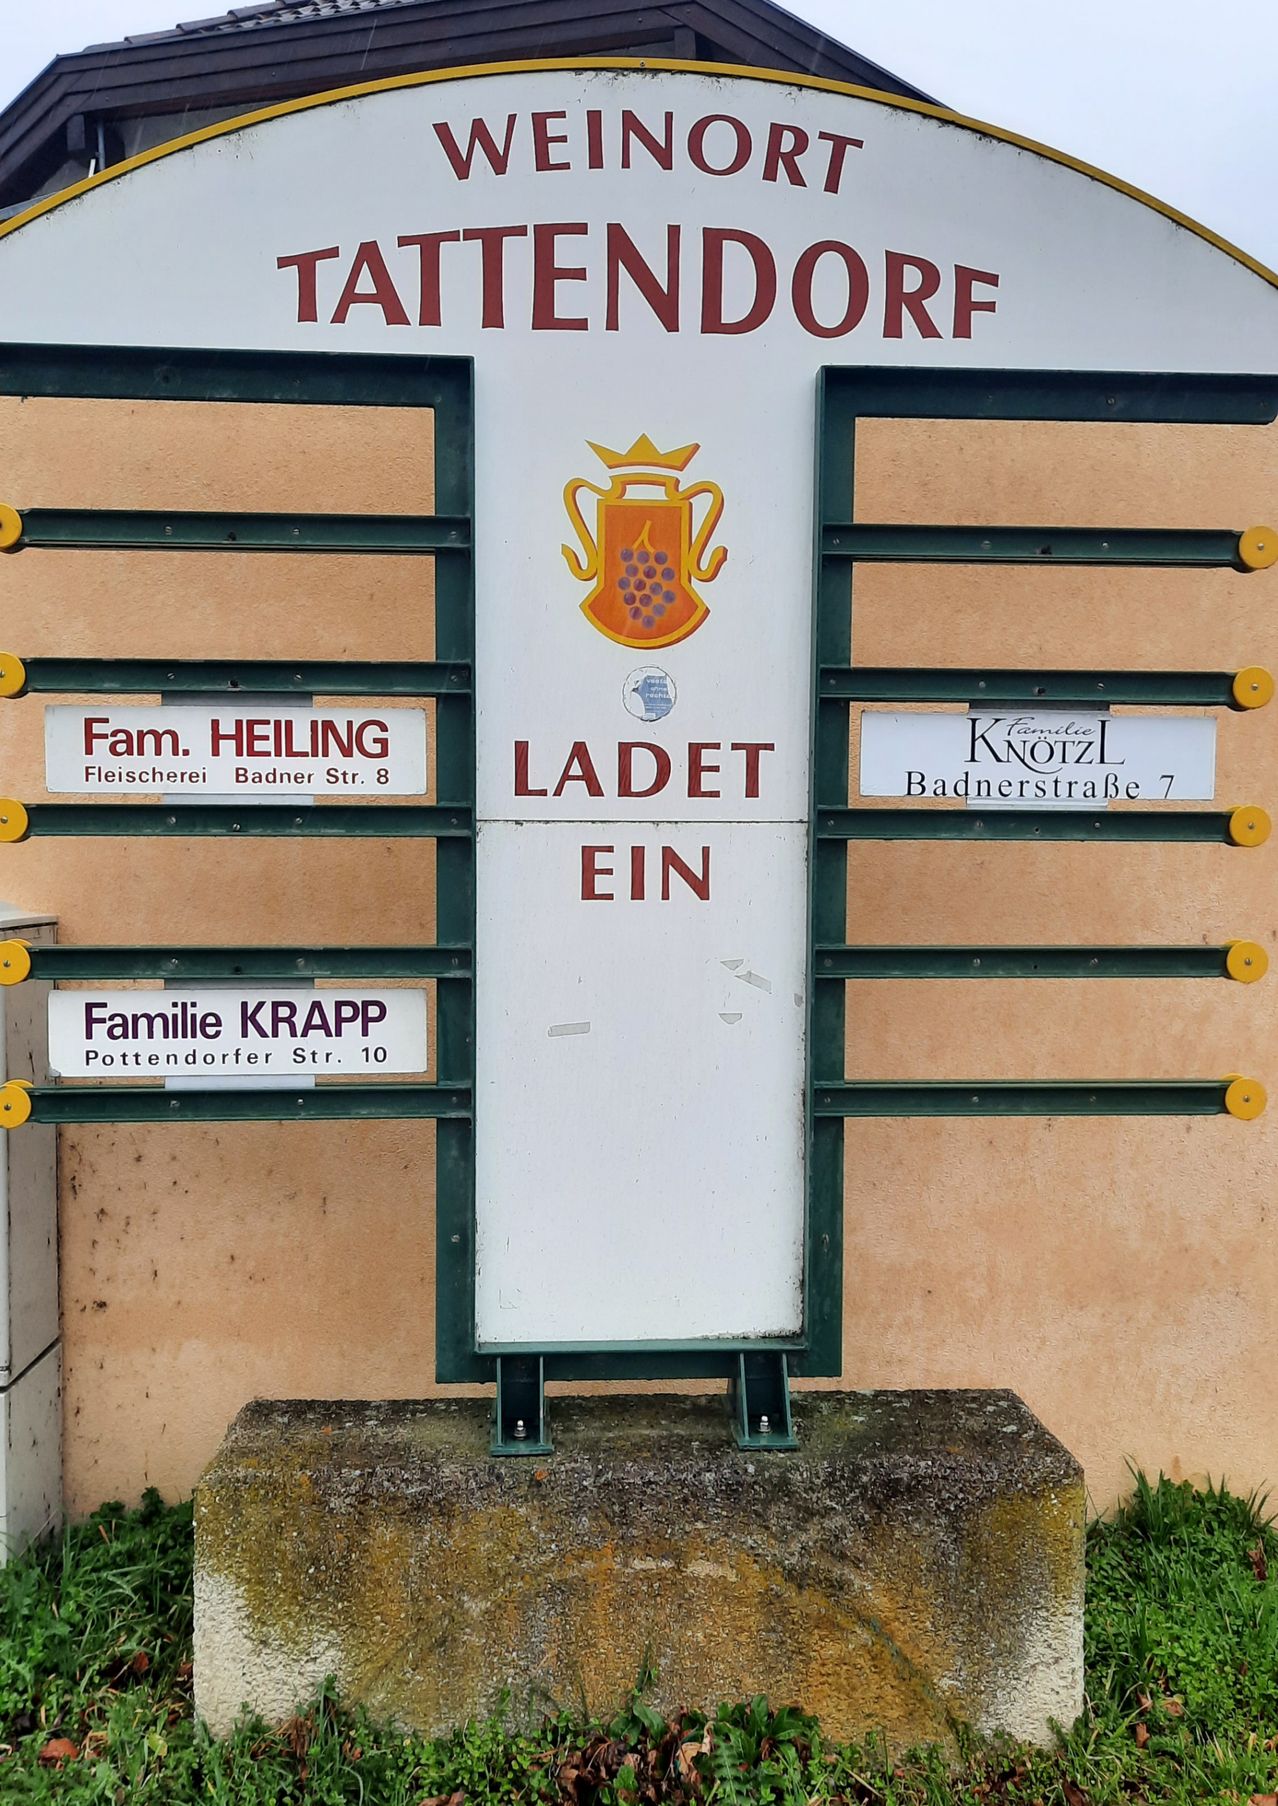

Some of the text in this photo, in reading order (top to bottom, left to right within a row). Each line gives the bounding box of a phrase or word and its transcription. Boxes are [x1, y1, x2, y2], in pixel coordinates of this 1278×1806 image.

[432, 109, 864, 194] WEINORT
[277, 223, 999, 339] TATTENDORF
[84, 718, 388, 758] Fam. HEILING
[1006, 716, 1095, 737] Familie
[85, 766, 389, 784] Fleischerei Badner Str. 8
[515, 741, 774, 798] LADET
[904, 770, 1174, 799] Badnerstraße 7
[581, 846, 710, 900] EIN
[85, 1000, 387, 1040] Familie KRAPP
[86, 1047, 386, 1066] Pottendorfer Str. 10
